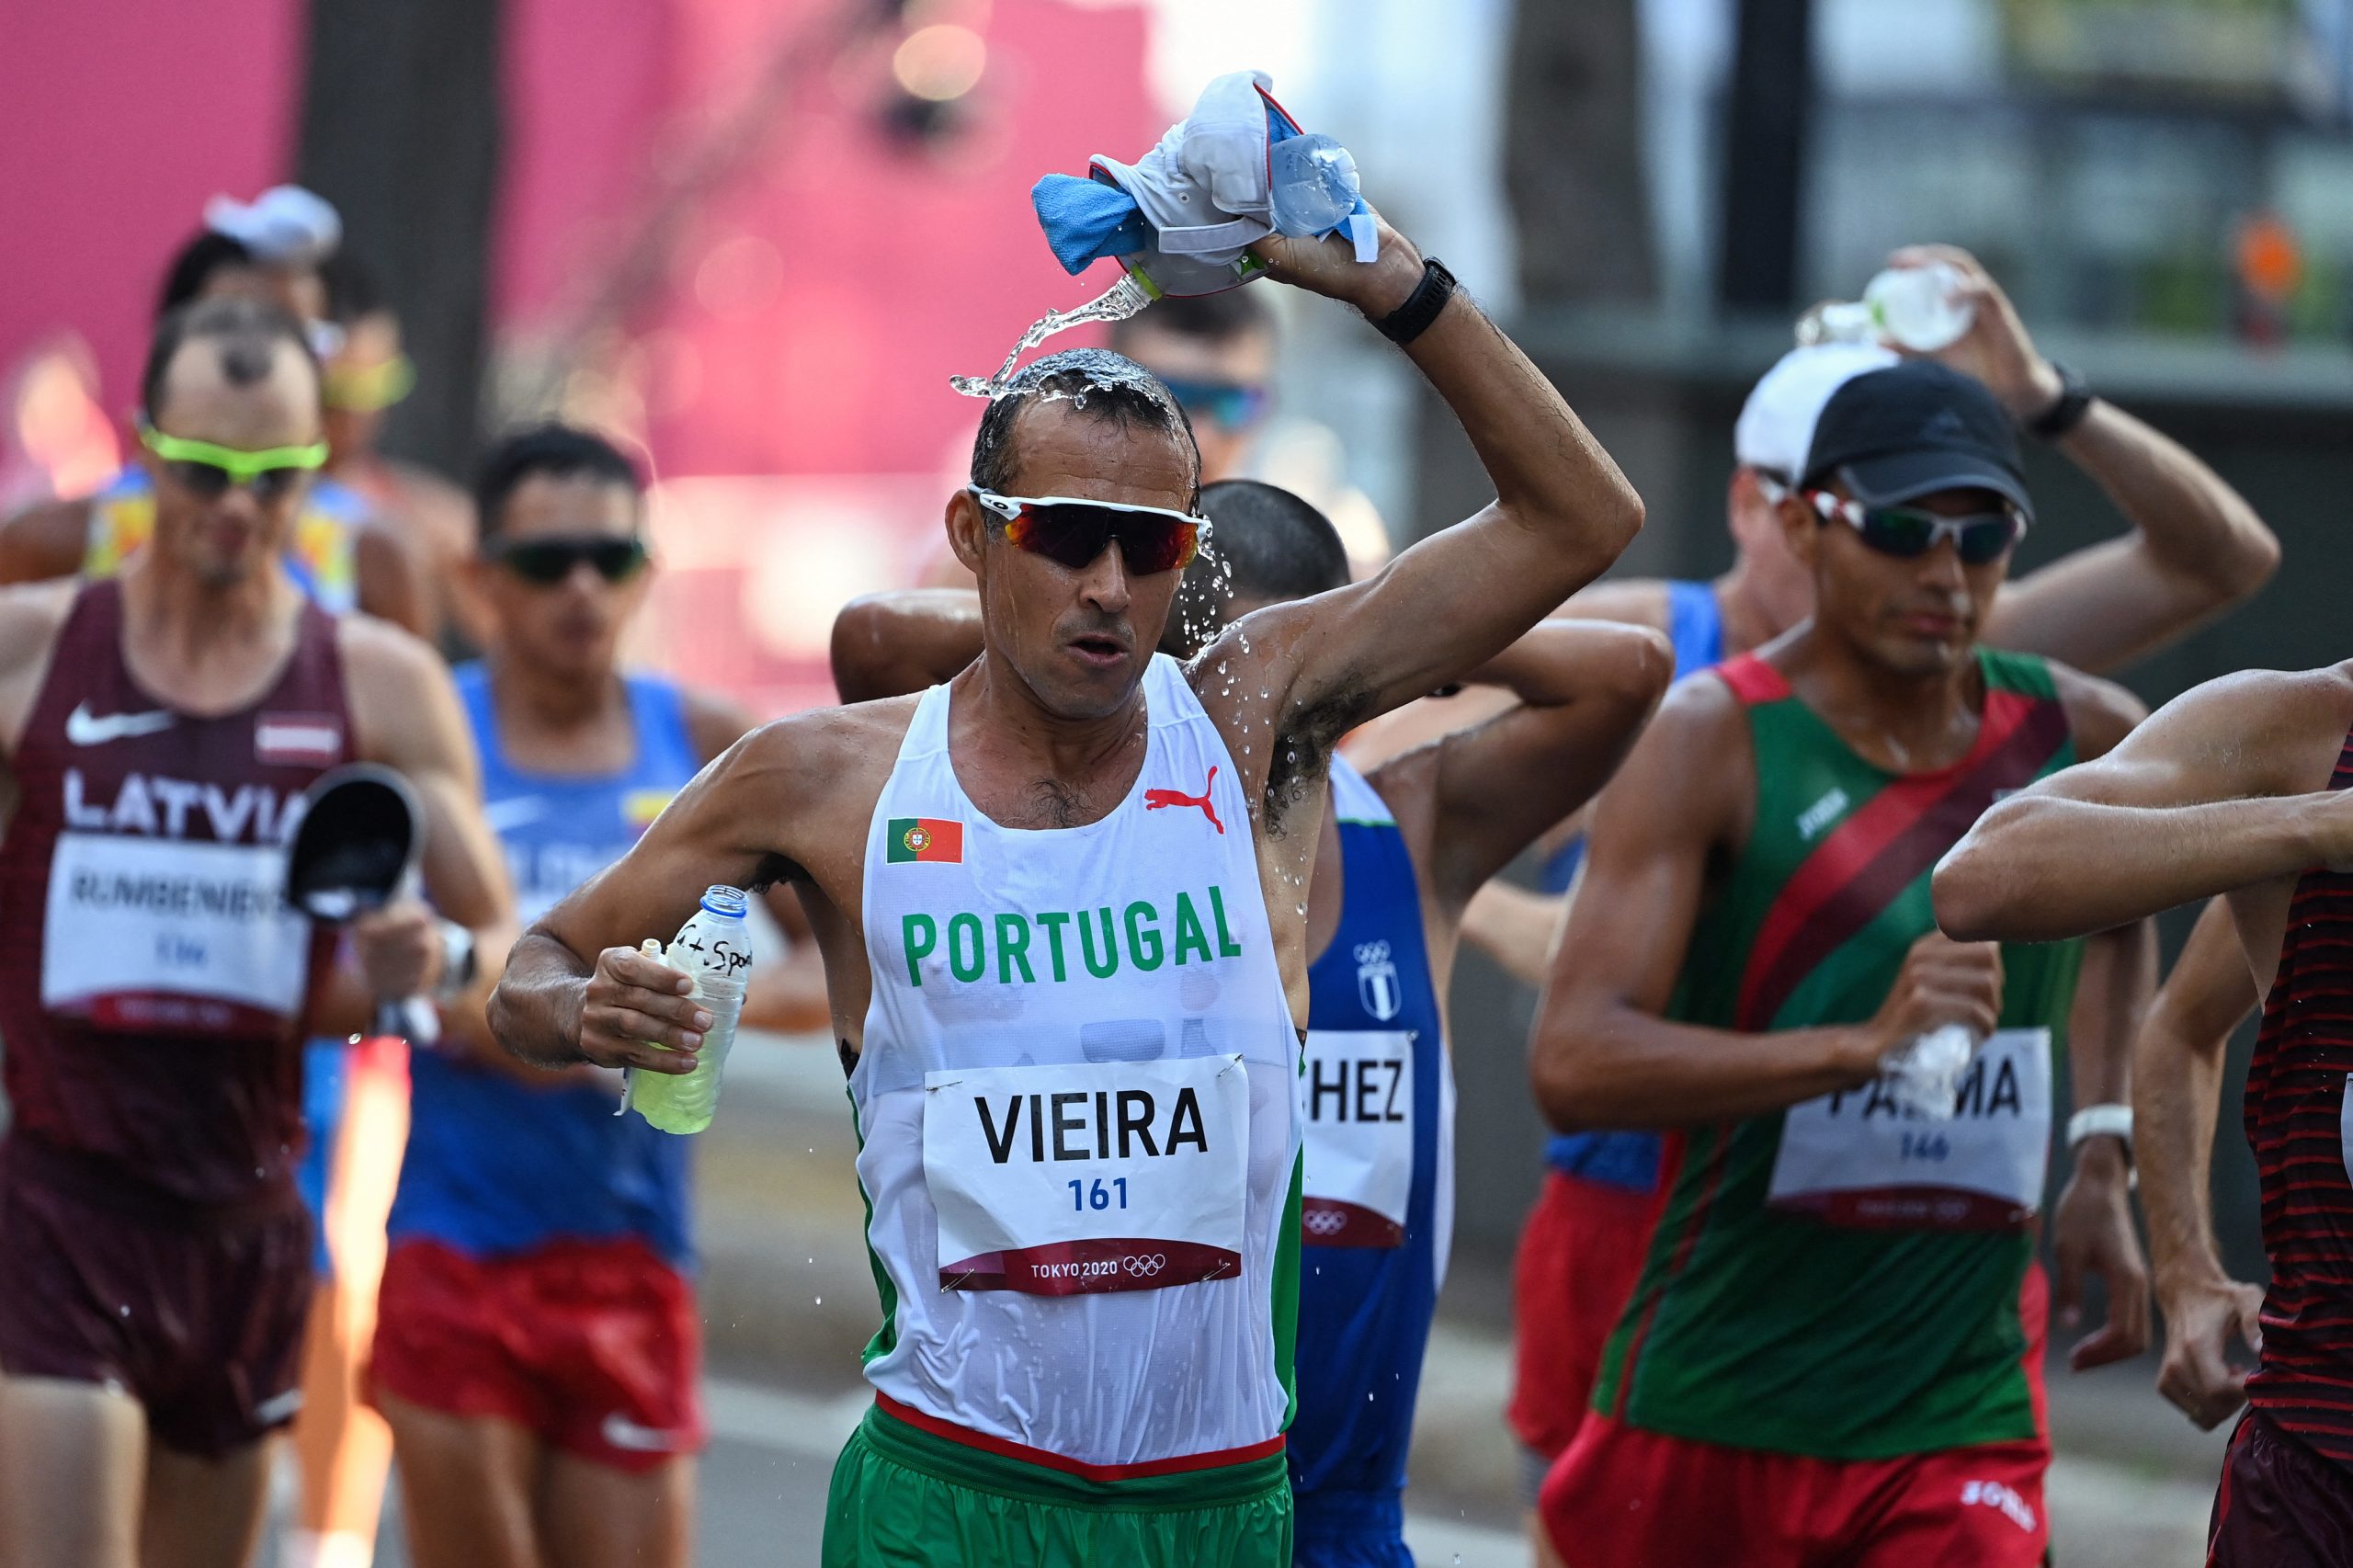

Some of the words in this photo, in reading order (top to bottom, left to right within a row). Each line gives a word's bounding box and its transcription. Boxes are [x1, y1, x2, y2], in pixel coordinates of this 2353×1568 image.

[902, 885, 1242, 987] PORTUGAL
[1302, 1059, 1404, 1123] HEZ
[974, 1087, 1208, 1164] VIEIRA
[1067, 1176, 1128, 1211] 161
[1031, 1262, 1080, 1278] TOKYO
[1081, 1260, 1119, 1277] 2020
